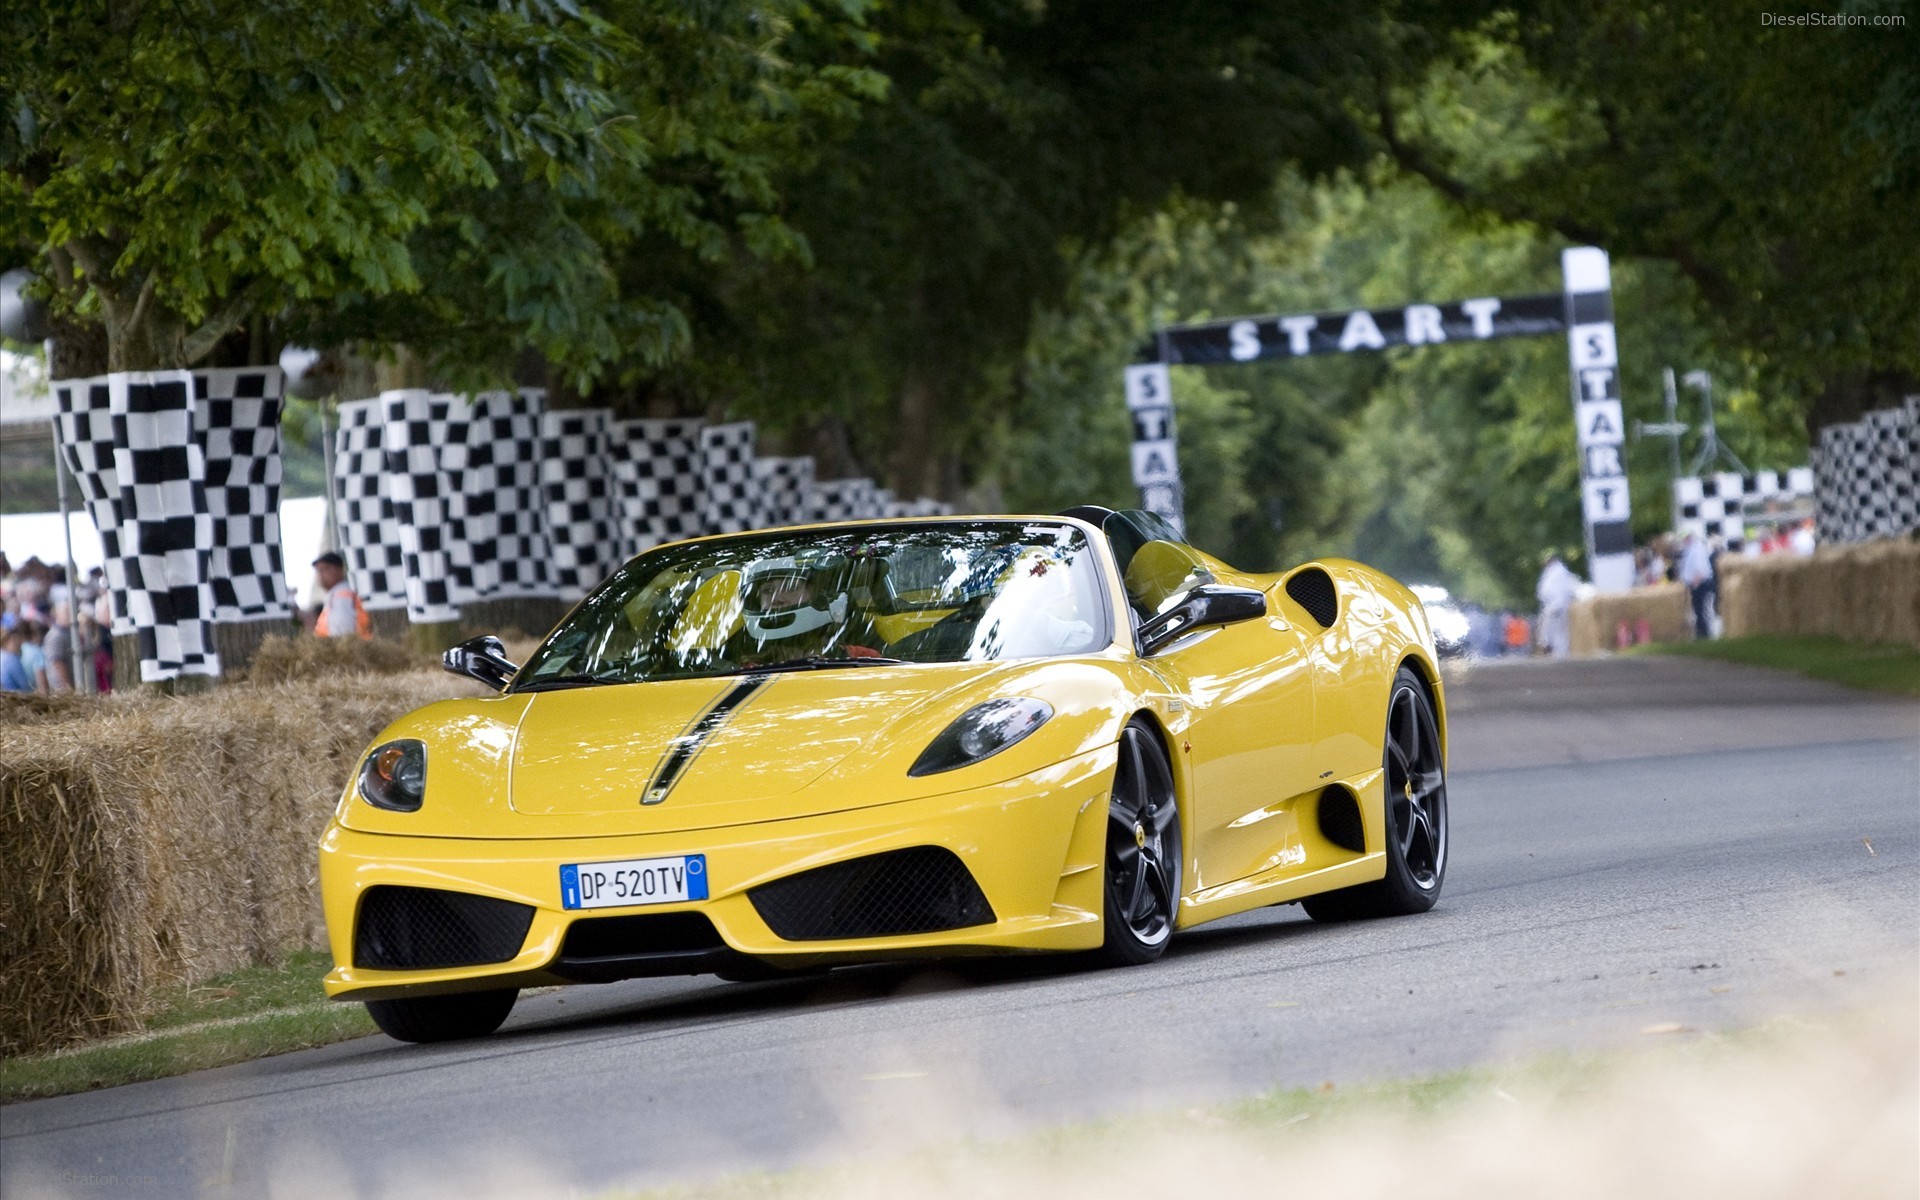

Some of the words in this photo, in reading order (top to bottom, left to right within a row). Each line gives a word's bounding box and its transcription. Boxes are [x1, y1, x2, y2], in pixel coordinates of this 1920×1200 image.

[1229, 297, 1500, 362] START
[1136, 372, 1175, 516] STAR
[1580, 333, 1624, 511] START
